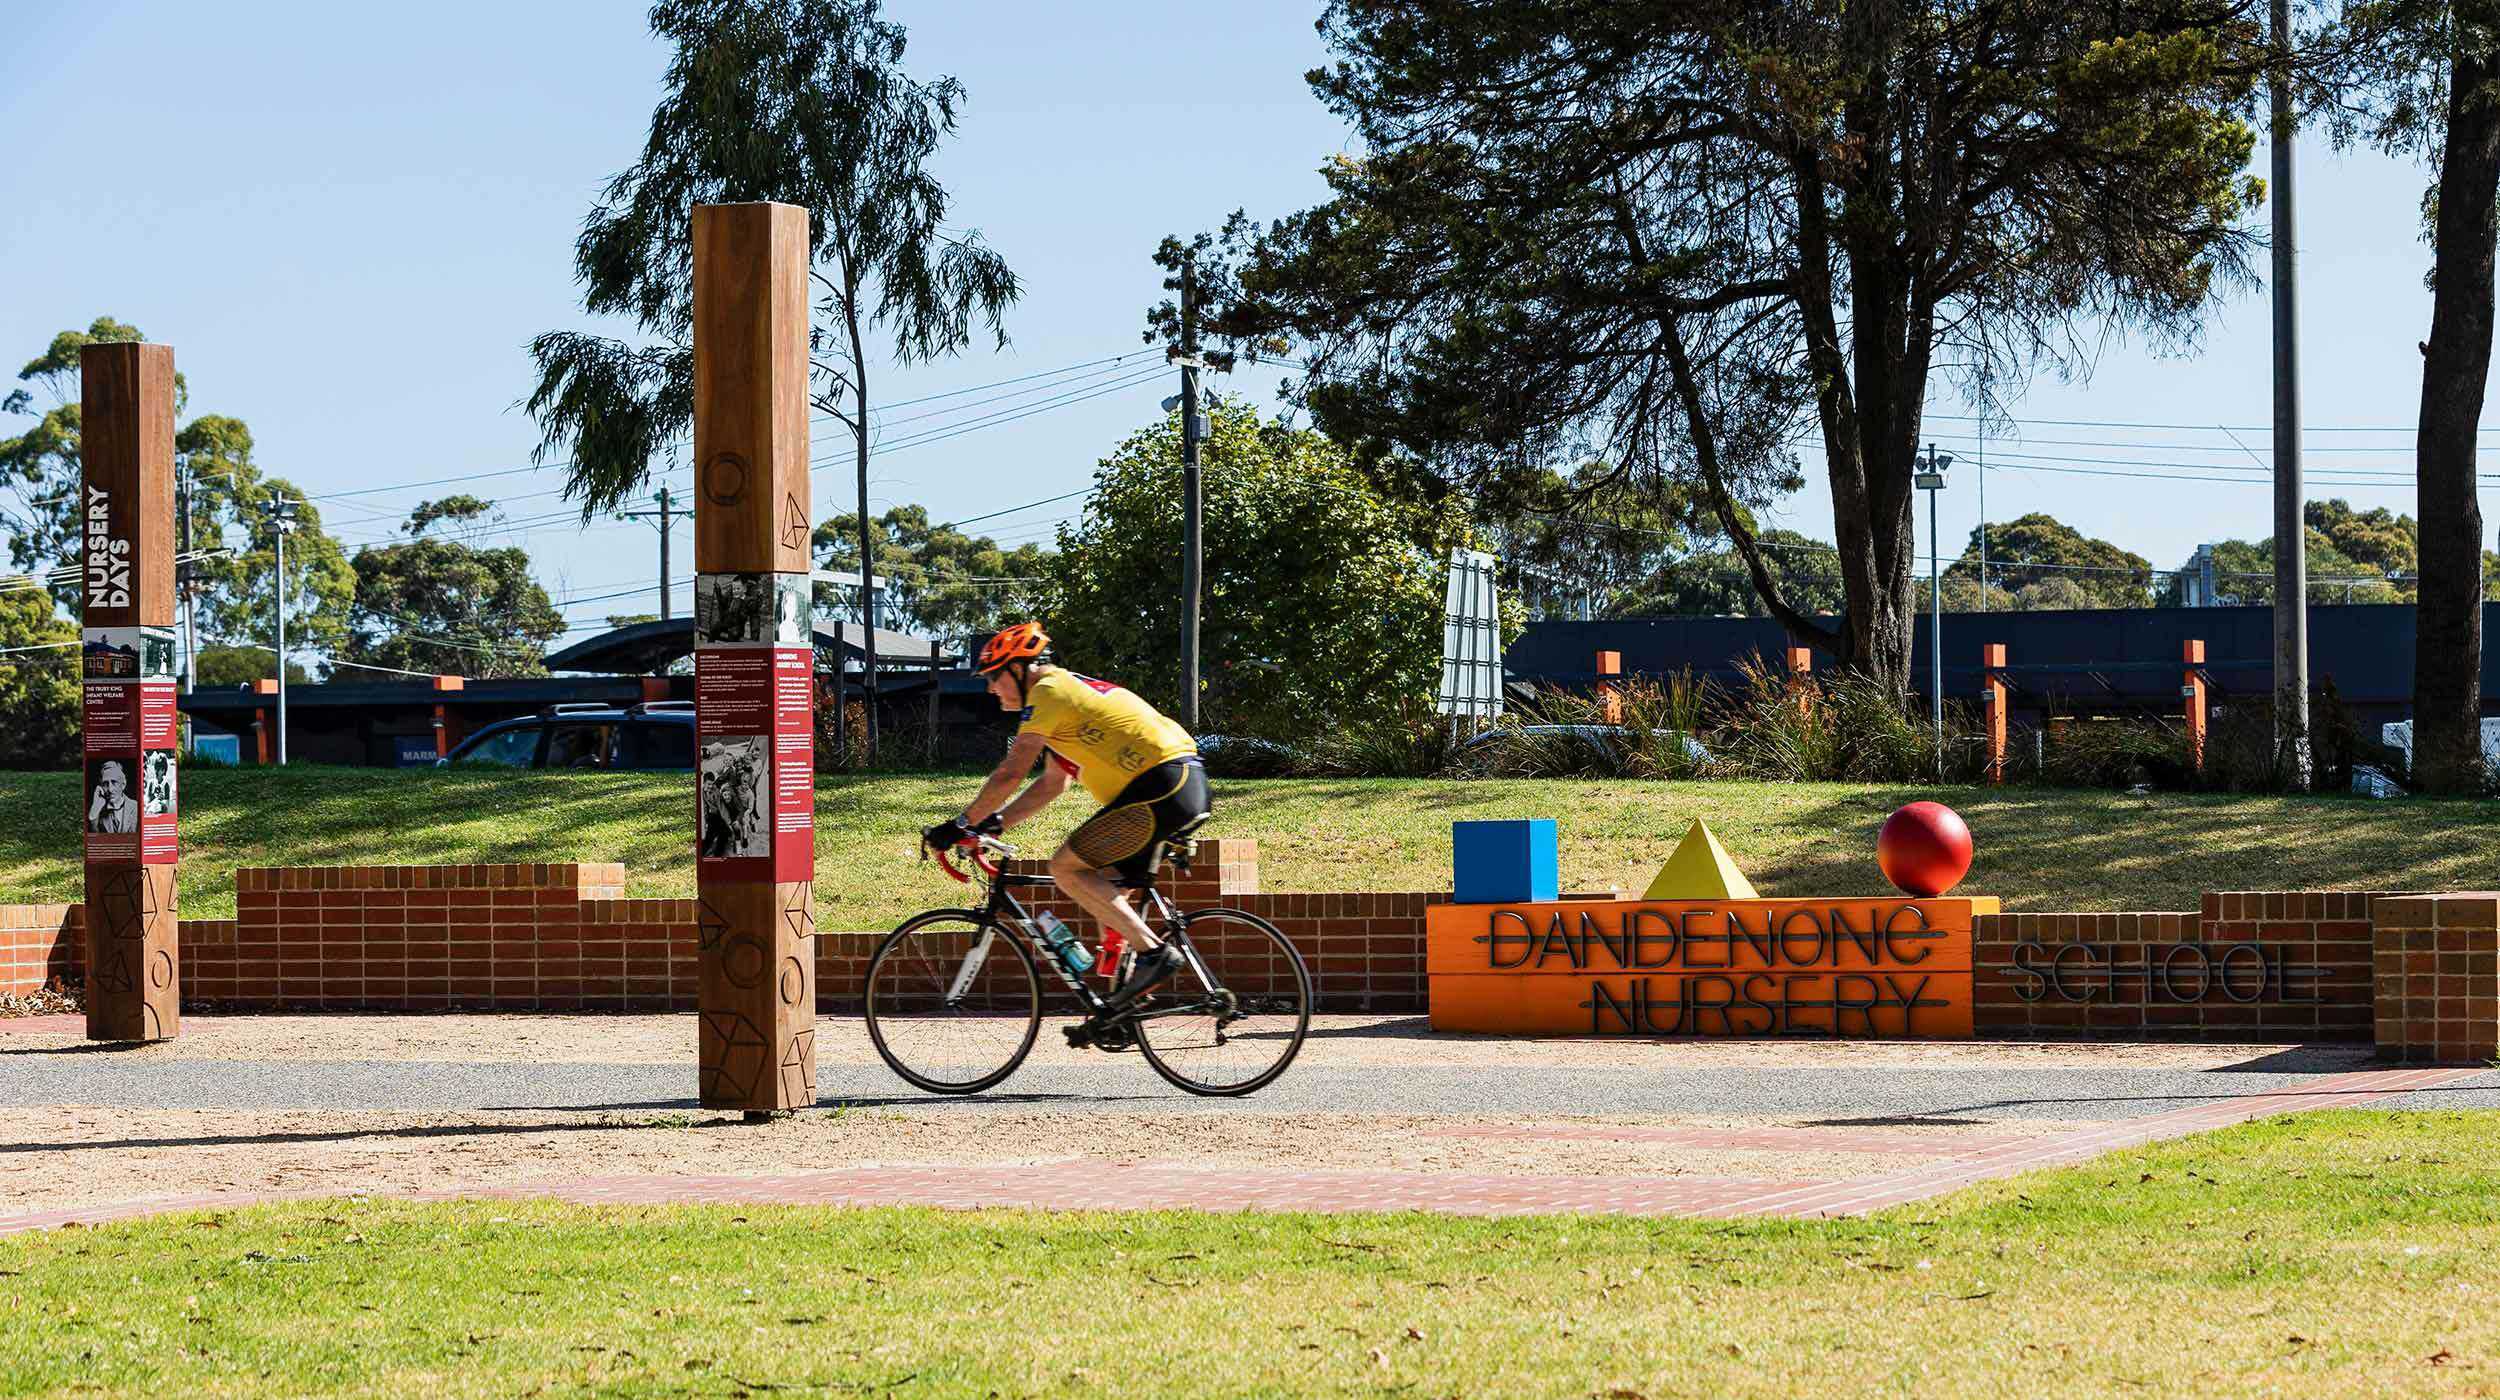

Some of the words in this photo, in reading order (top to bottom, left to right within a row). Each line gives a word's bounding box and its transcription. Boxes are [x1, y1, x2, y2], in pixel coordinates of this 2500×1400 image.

[88, 485, 109, 607] NURSERY
[109, 539, 130, 607] DAYS
[1488, 905, 1931, 969] DANDENONG
[2011, 943, 2328, 1002] SCHOOL
[1590, 974, 1930, 1037] NURSERY
